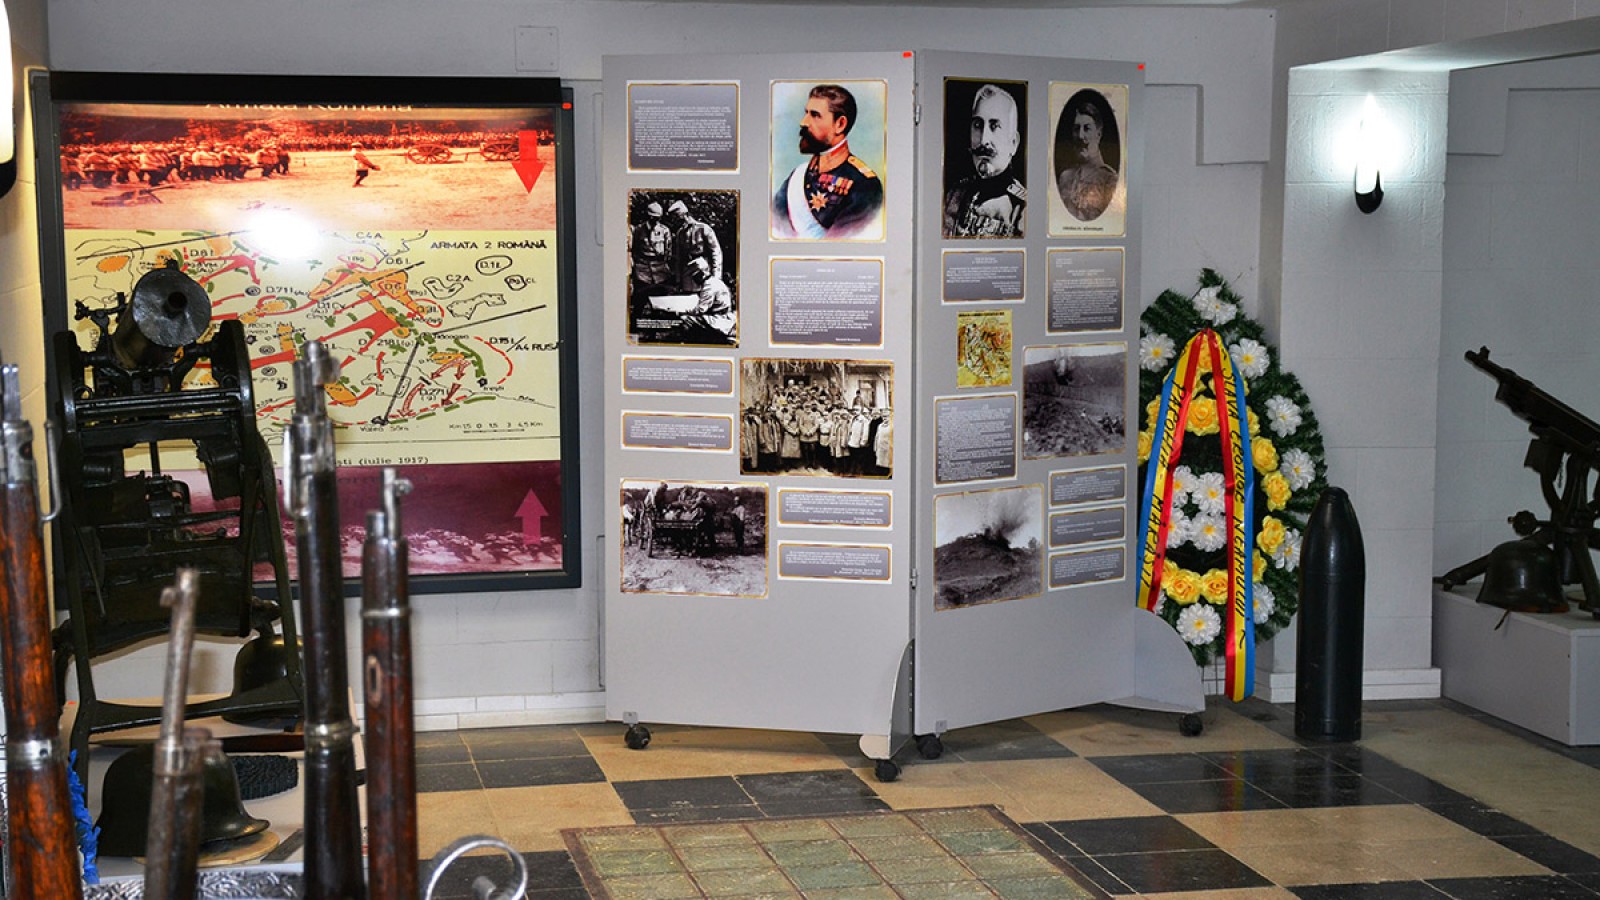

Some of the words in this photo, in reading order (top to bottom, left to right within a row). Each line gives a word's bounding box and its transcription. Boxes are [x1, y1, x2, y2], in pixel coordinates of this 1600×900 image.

[430, 240, 478, 249] ARMATA
[484, 240, 492, 249] 2
[497, 238, 547, 249] ROMÂNĂ
[358, 456, 392, 467] (iulie
[399, 456, 429, 466] 1917)
[1160, 379, 1187, 472] PAROHIA
[1230, 430, 1246, 504] EROILOR
[1232, 515, 1250, 620] NEAMULUI
